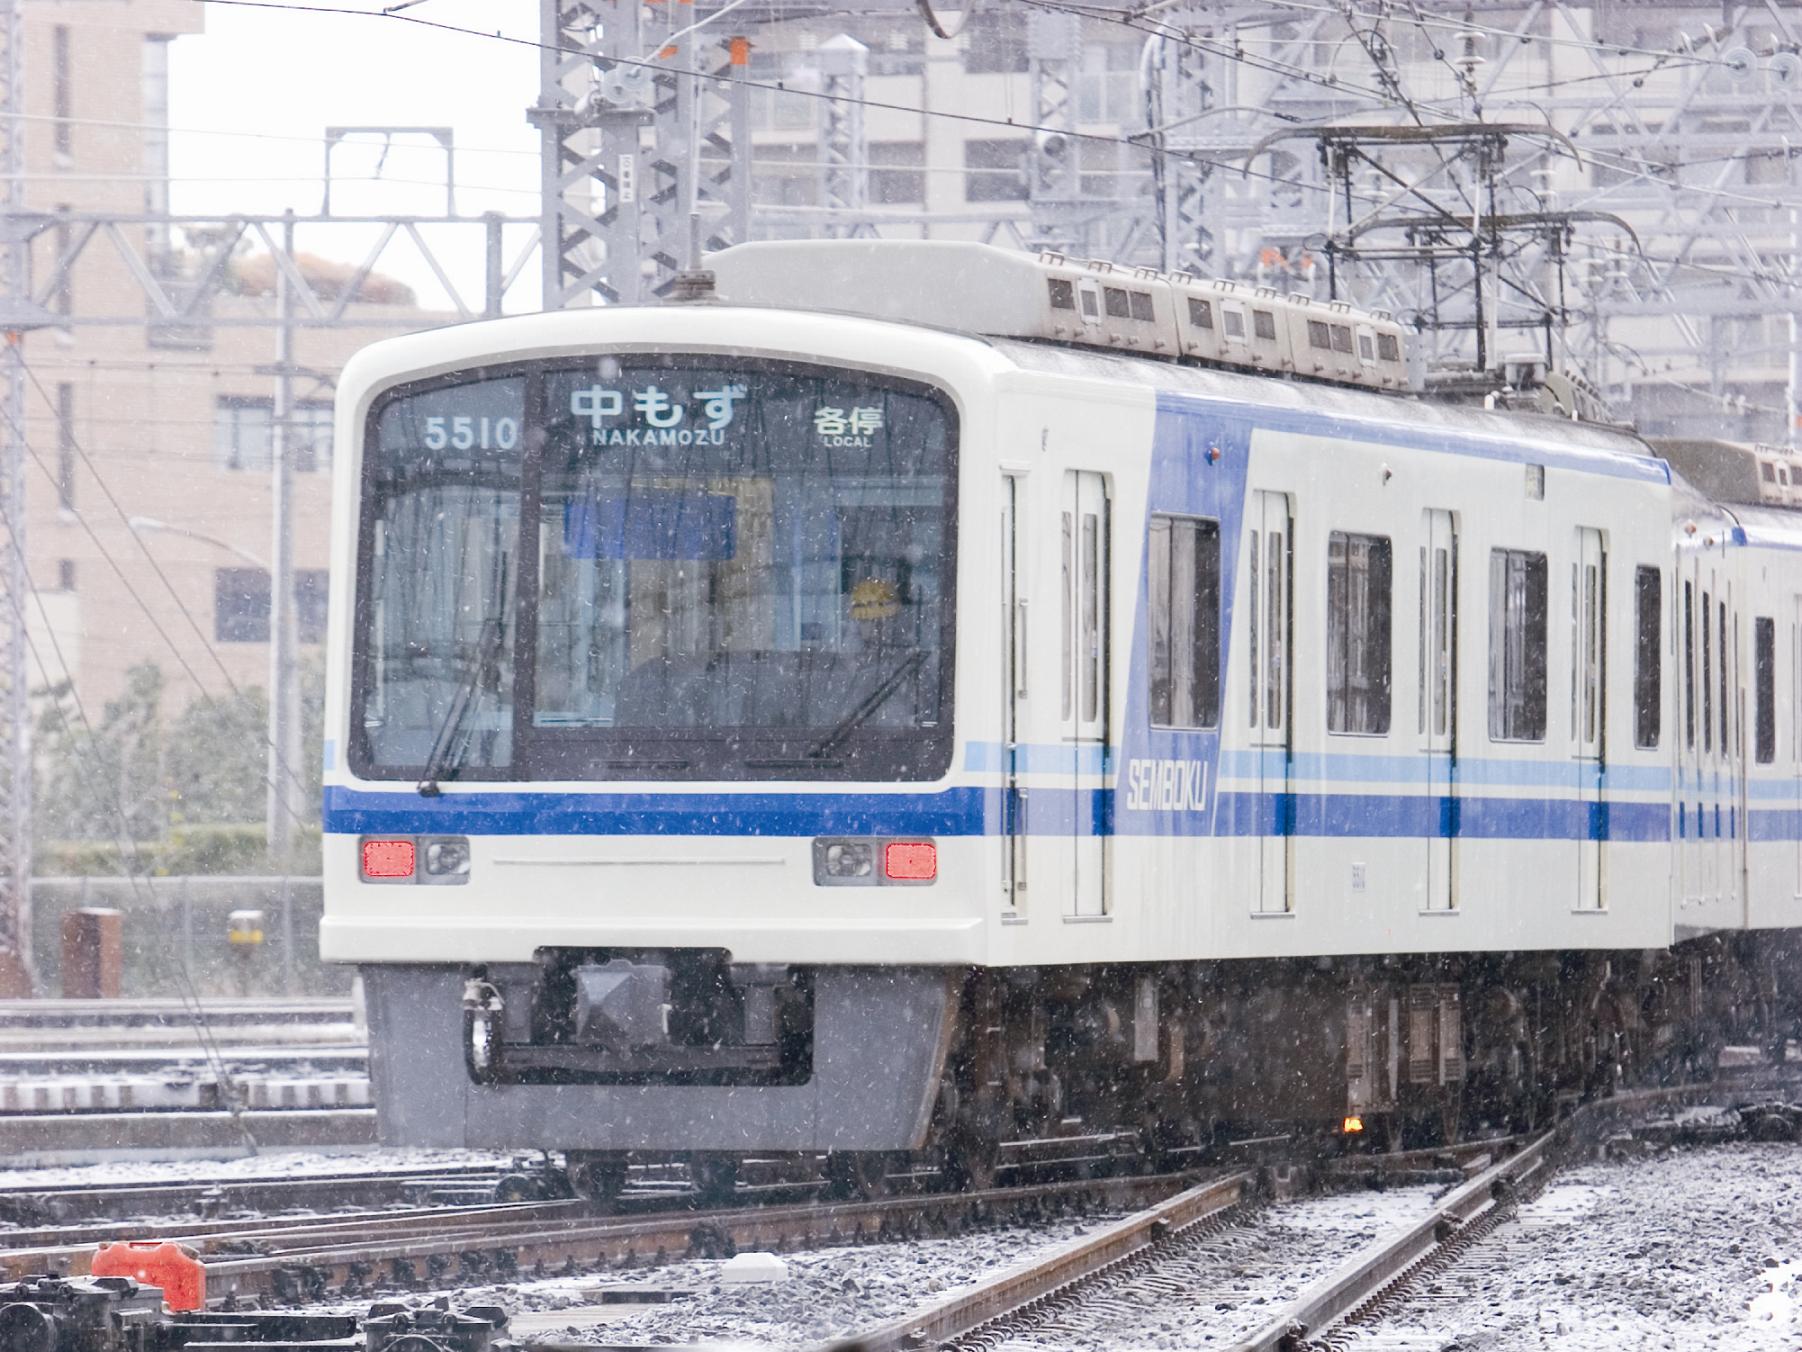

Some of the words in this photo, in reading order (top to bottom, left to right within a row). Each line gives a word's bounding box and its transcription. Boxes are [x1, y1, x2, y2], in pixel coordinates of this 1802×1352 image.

[571, 384, 748, 430] 中もず
[813, 406, 884, 435] 各停
[424, 416, 518, 450] 5510
[593, 429, 725, 446] NAKAMOZU
[823, 436, 873, 448] LOCAL
[1127, 758, 1209, 812] SEMBOKU
